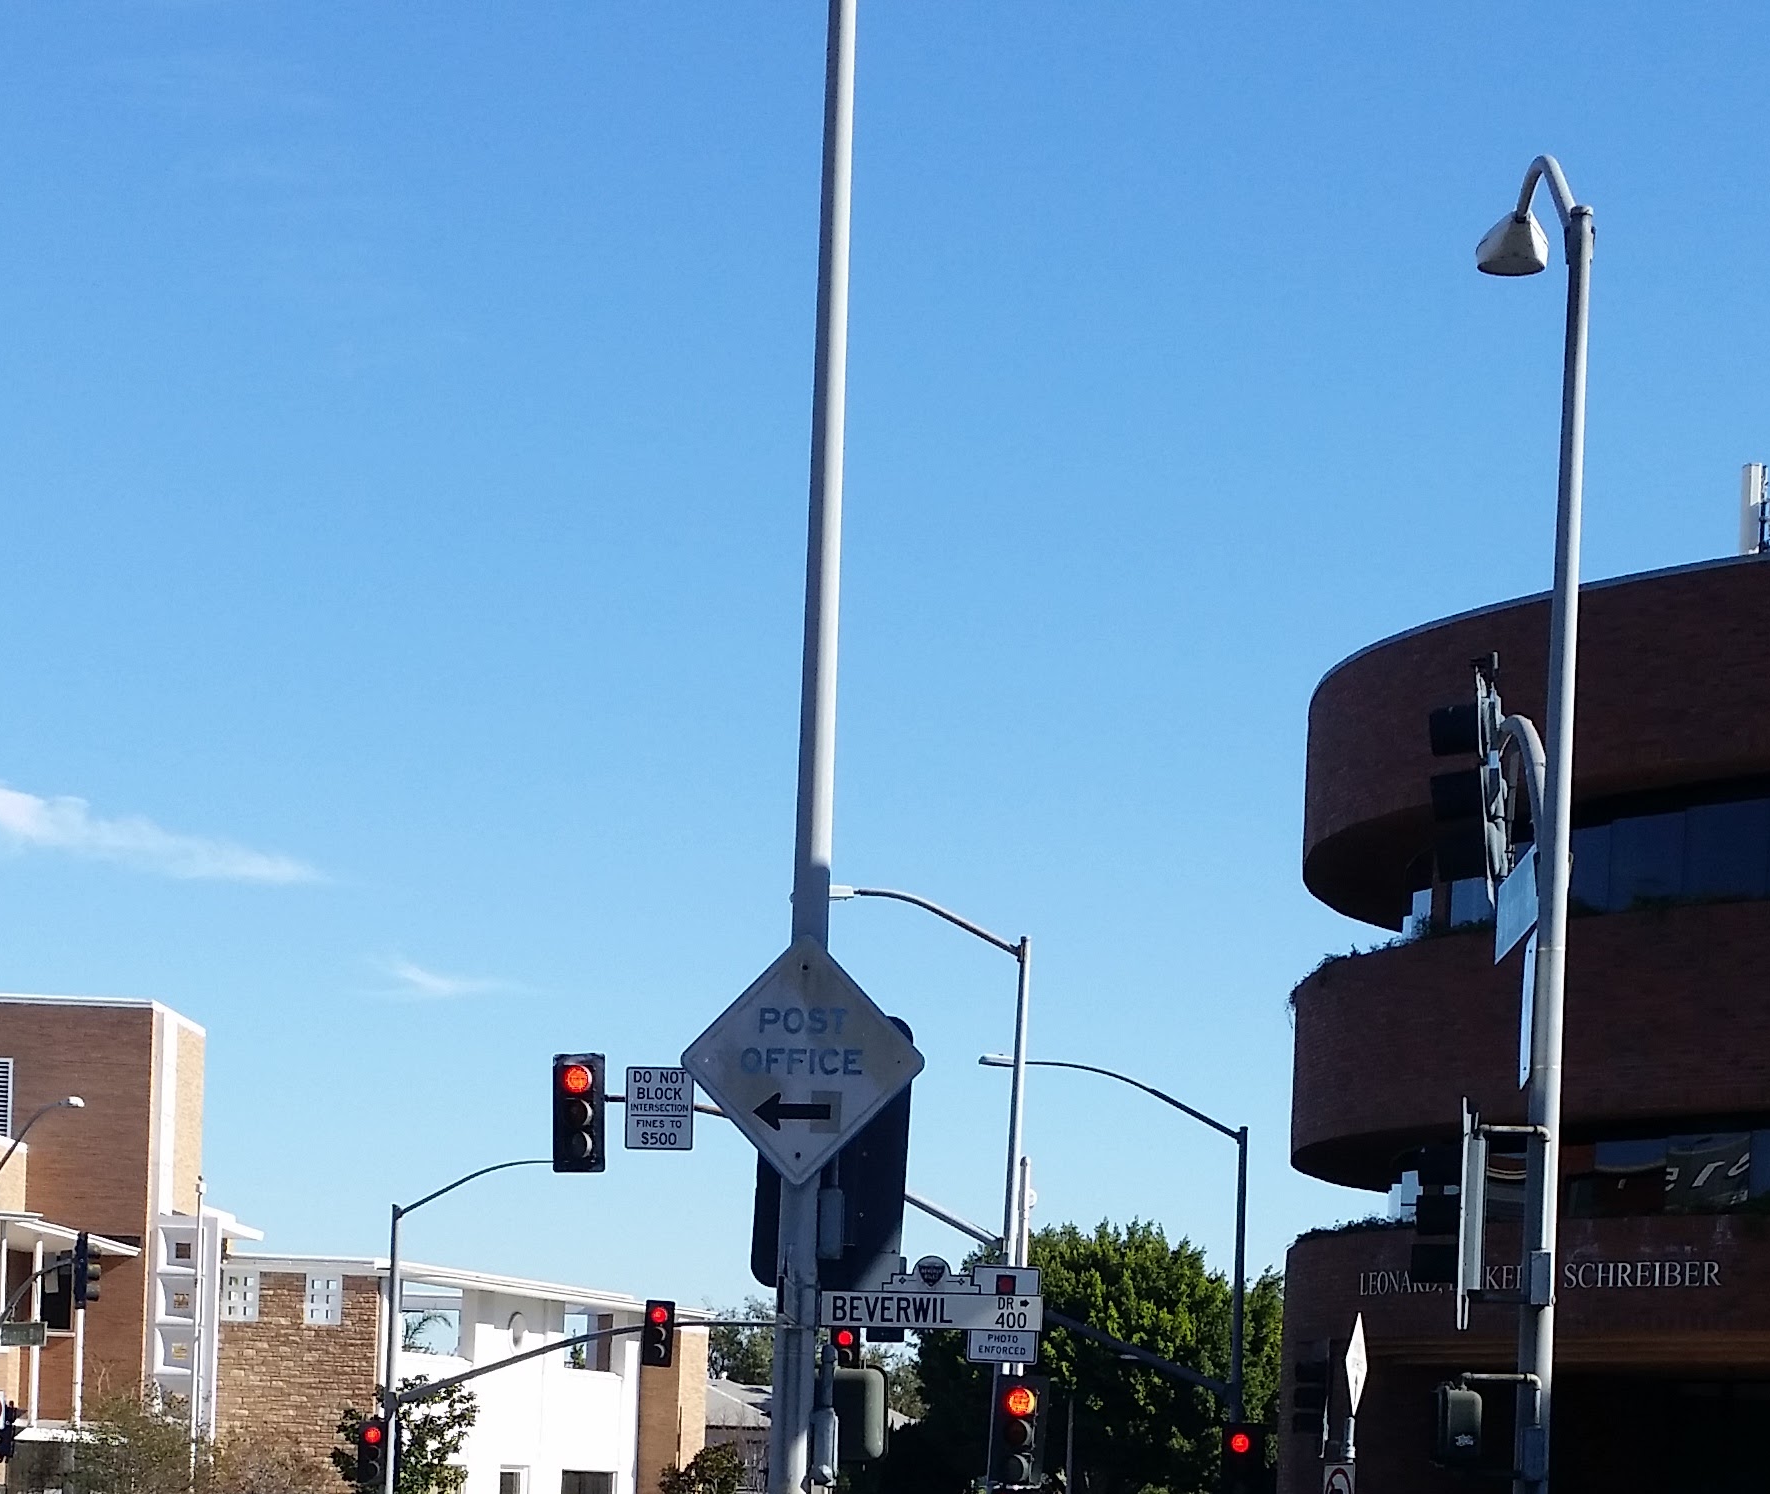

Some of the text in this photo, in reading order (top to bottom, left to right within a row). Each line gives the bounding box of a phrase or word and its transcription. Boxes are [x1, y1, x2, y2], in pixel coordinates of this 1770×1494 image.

[759, 1007, 847, 1034] POST
[741, 1047, 863, 1075] OFFICE
[633, 1070, 687, 1084] DO NOT
[636, 1087, 682, 1101] BLOCK
[630, 1103, 689, 1113] INTERSECTION
[636, 1119, 682, 1129] FINES TO
[641, 1131, 677, 1146] $500
[1563, 1260, 1722, 1289] SCHREIBER
[832, 1295, 1014, 1324] BEVERWIL DR
[994, 1312, 1027, 1329] 400
[987, 1334, 1019, 1344] PHOTO
[978, 1345, 1026, 1356] ENFORCED
